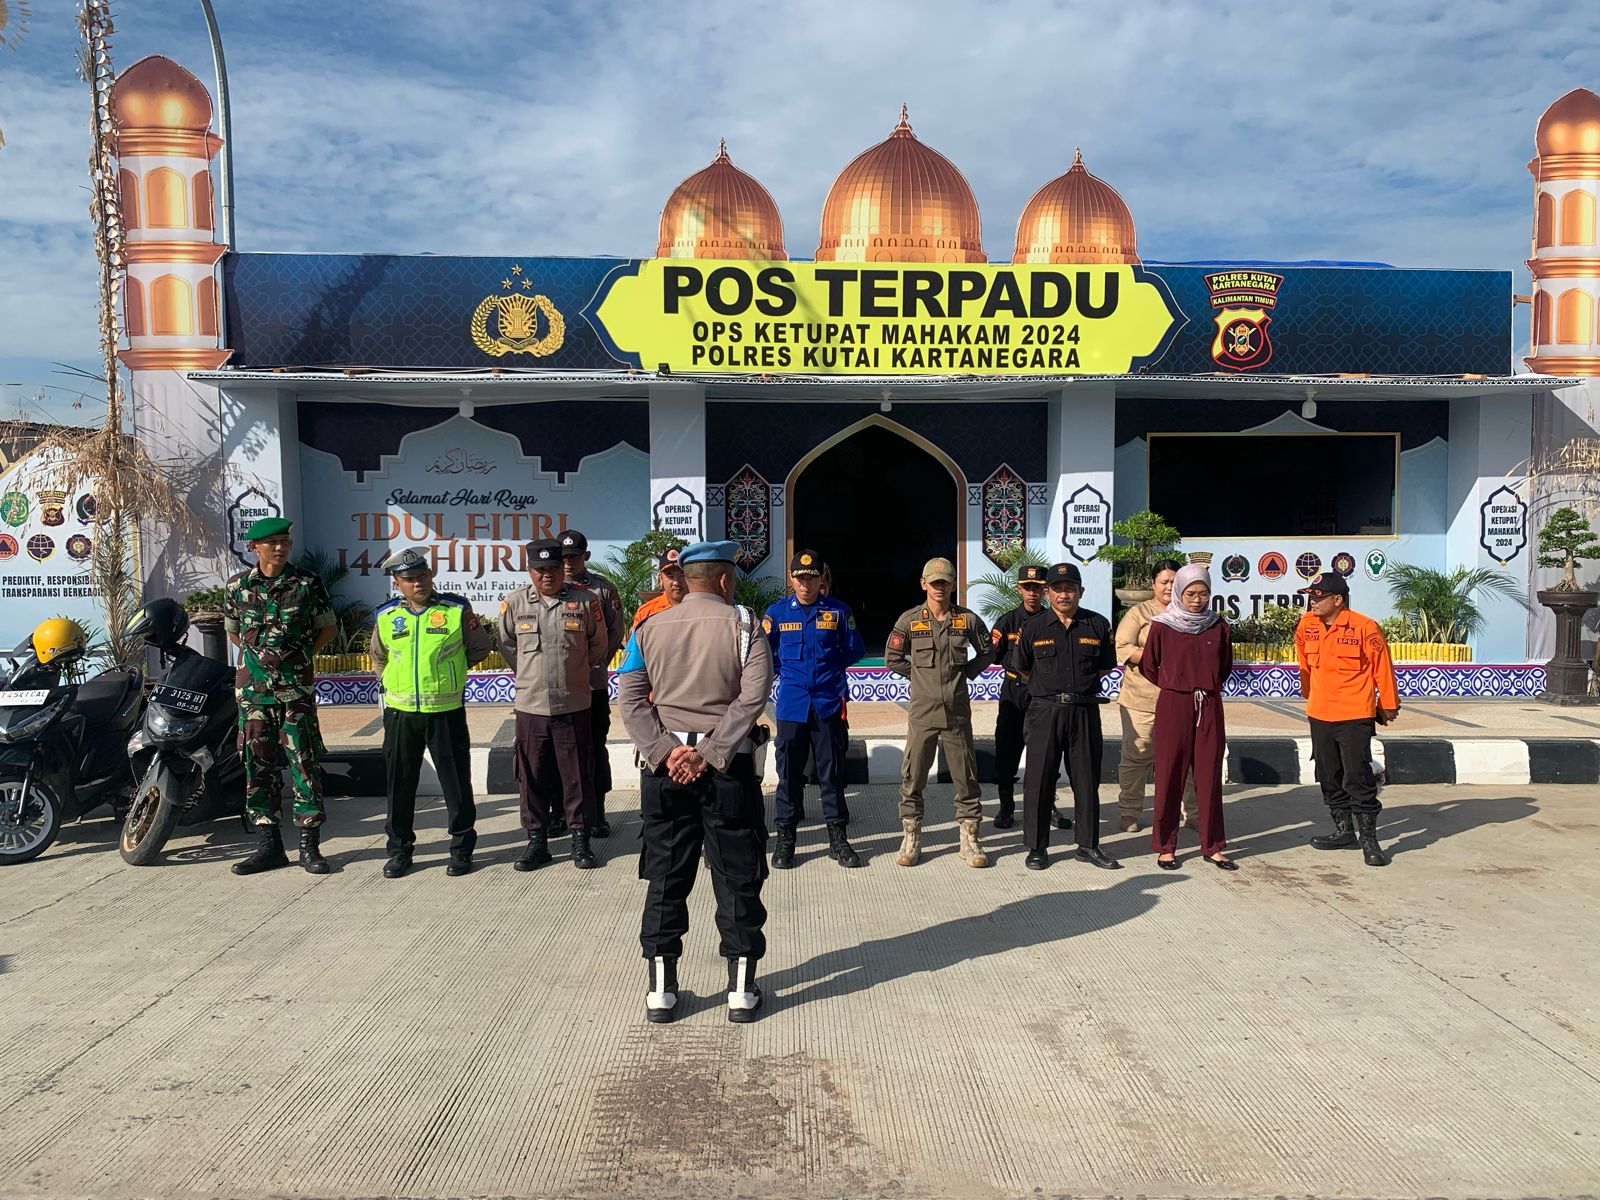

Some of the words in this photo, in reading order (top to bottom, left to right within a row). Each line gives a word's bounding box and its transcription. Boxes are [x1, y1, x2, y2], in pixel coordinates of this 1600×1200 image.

[1212, 274, 1248, 284] POLRES
[1250, 273, 1276, 284] KUTAI
[1212, 280, 1275, 291] KARTANEGARA
[663, 265, 796, 317] POS
[815, 270, 1120, 319] TERPADU
[1213, 296, 1253, 305] KALIMANTAN
[1254, 296, 1274, 305] TIMUR
[692, 321, 743, 343] OPS
[754, 322, 871, 344] KETUPAT
[882, 324, 1010, 345] MAHAKAM
[1021, 324, 1081, 345] 2024
[692, 345, 792, 366] POLRES
[803, 346, 880, 367] KUTAI
[891, 347, 1081, 368] KARTANEGARA
[386, 488, 450, 506] Selamat
[449, 488, 492, 506] Hari
[494, 488, 537, 511] Raya
[240, 508, 269, 517] OPERASI
[664, 505, 692, 514] OPERASI
[1073, 504, 1100, 513] OPERASI
[1491, 505, 1518, 514] OPERASI
[664, 516, 693, 525] KETUPAT
[1073, 515, 1101, 524] KETUPAT
[1491, 516, 1518, 525] KETUPAT
[351, 512, 457, 541] IDUL
[466, 512, 568, 541] FITRI
[1069, 526, 1104, 535] MAHAKAM
[1487, 527, 1521, 536] MAHAKAM
[1077, 538, 1095, 546] 2024
[1495, 538, 1513, 547] 2024
[2, 575, 45, 587] PREDIKTIF,
[466, 581, 488, 591] Wal
[2, 587, 61, 598] TRANSPARANSI
[497, 592, 506, 602] &
[1212, 594, 1241, 620] OS
[153, 685, 167, 695] KT
[170, 689, 193, 701] 3125
